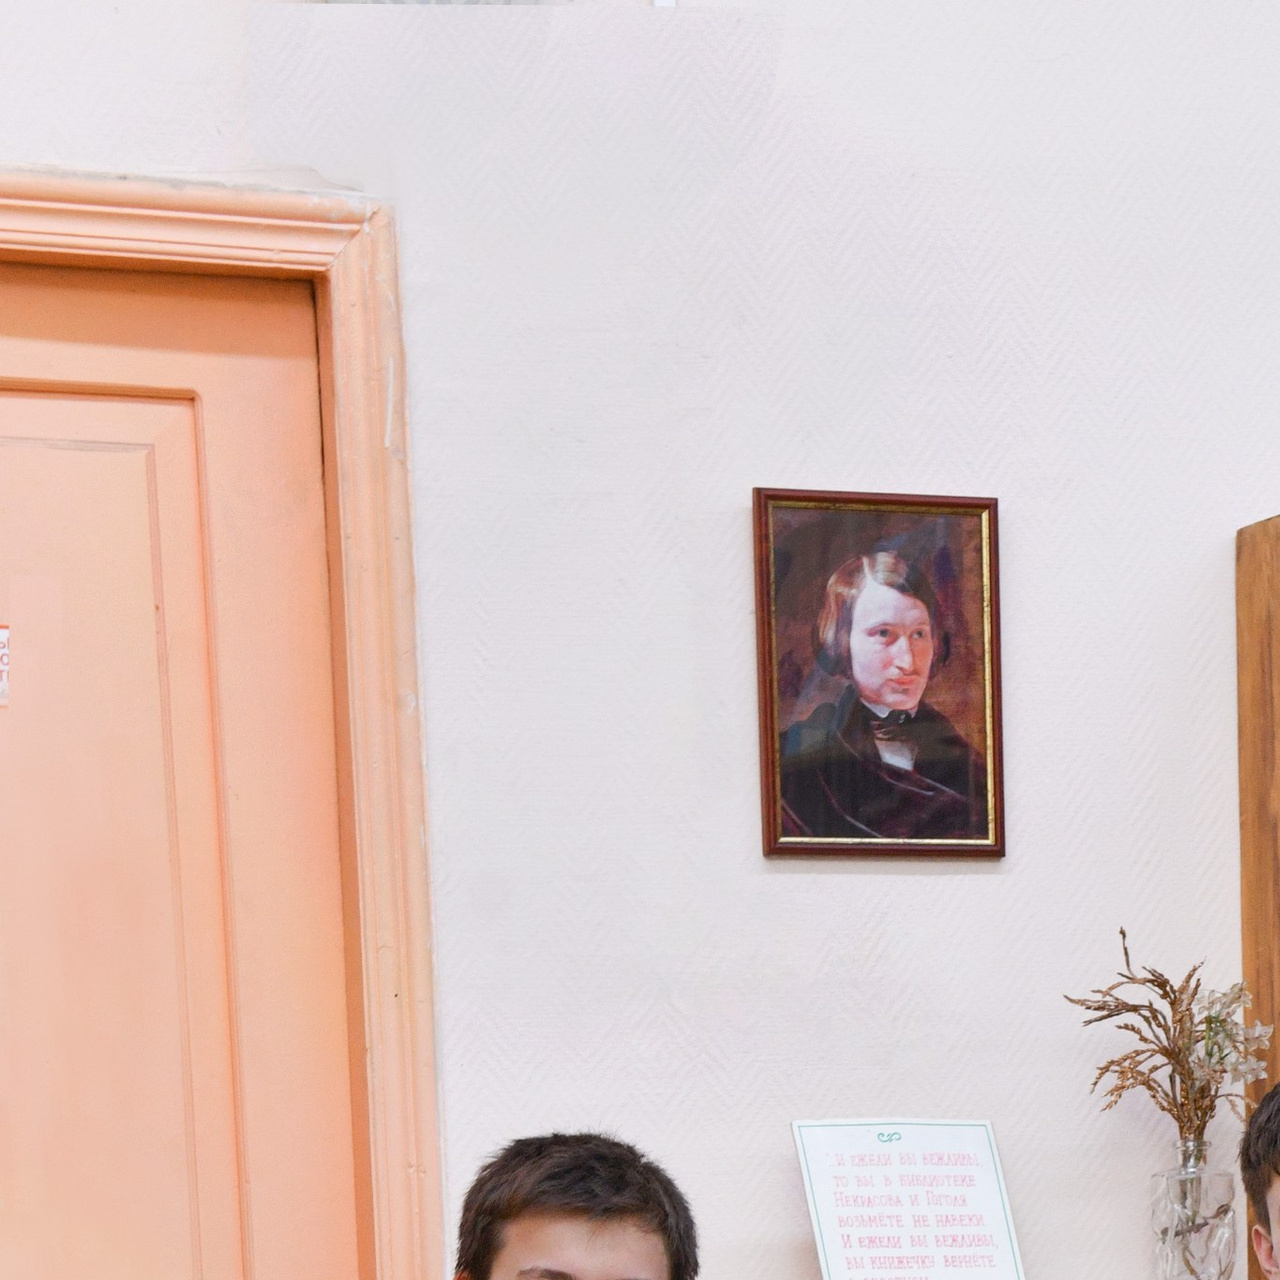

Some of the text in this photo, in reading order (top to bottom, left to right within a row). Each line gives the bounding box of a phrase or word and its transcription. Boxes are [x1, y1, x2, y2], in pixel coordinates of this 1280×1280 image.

[851, 1154, 892, 1167] ЕЖЕЛИ
[900, 1153, 918, 1166] ВЫ
[833, 1174, 976, 1188] ТО ВЫ В БИБЛИОТЕКЕ
[910, 1194, 920, 1206] И
[913, 1214, 930, 1227] НЕ
[936, 1214, 985, 1227] НАВЕКИ
[842, 1234, 999, 1249] И ЕЖЕЛИ ВЫ ВЕЖЛИВЫ,
[847, 1256, 865, 1270] ВЫ
[871, 1255, 936, 1270] КНИЖЕЧКУ
